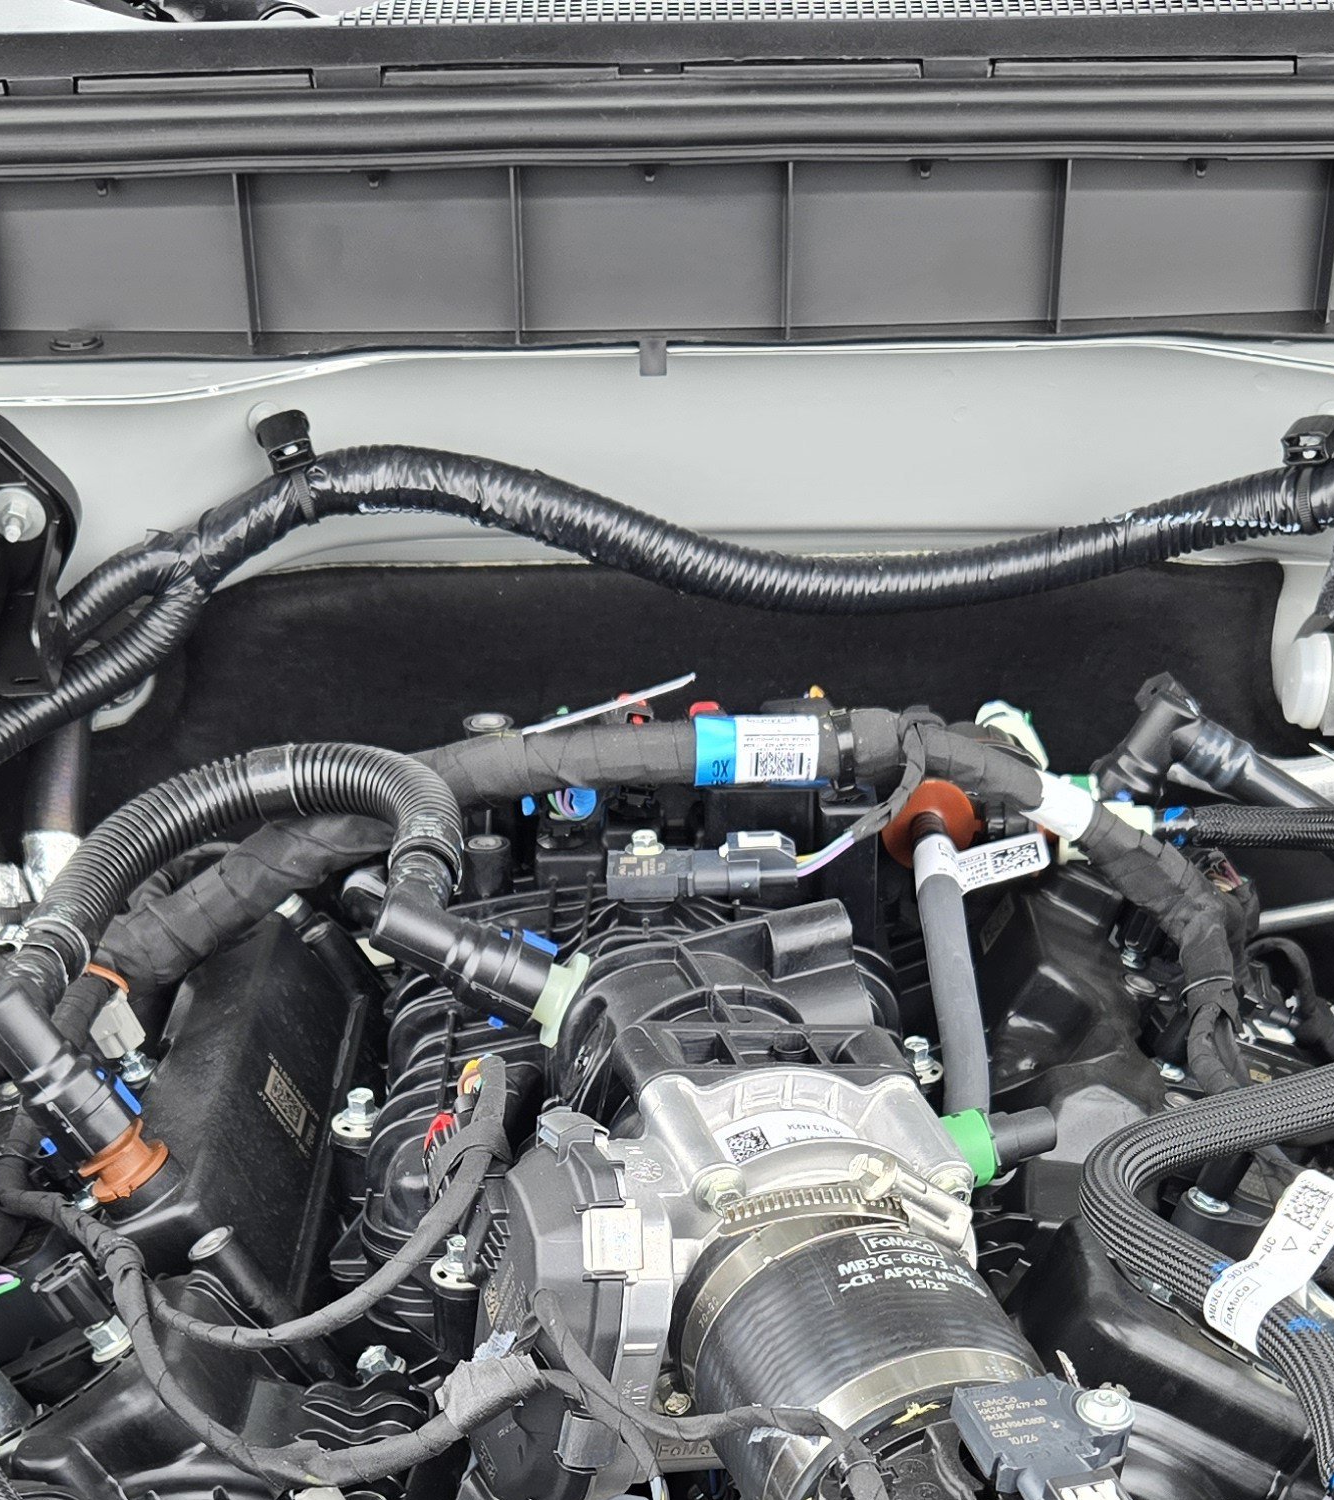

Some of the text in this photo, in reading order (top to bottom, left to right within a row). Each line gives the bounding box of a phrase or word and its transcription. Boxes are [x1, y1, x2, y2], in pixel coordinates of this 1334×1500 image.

[868, 1236, 937, 1252] FoMoCo
[1223, 1284, 1250, 1326] FoMoCo
[972, 1396, 1018, 1409] FoMoCo
